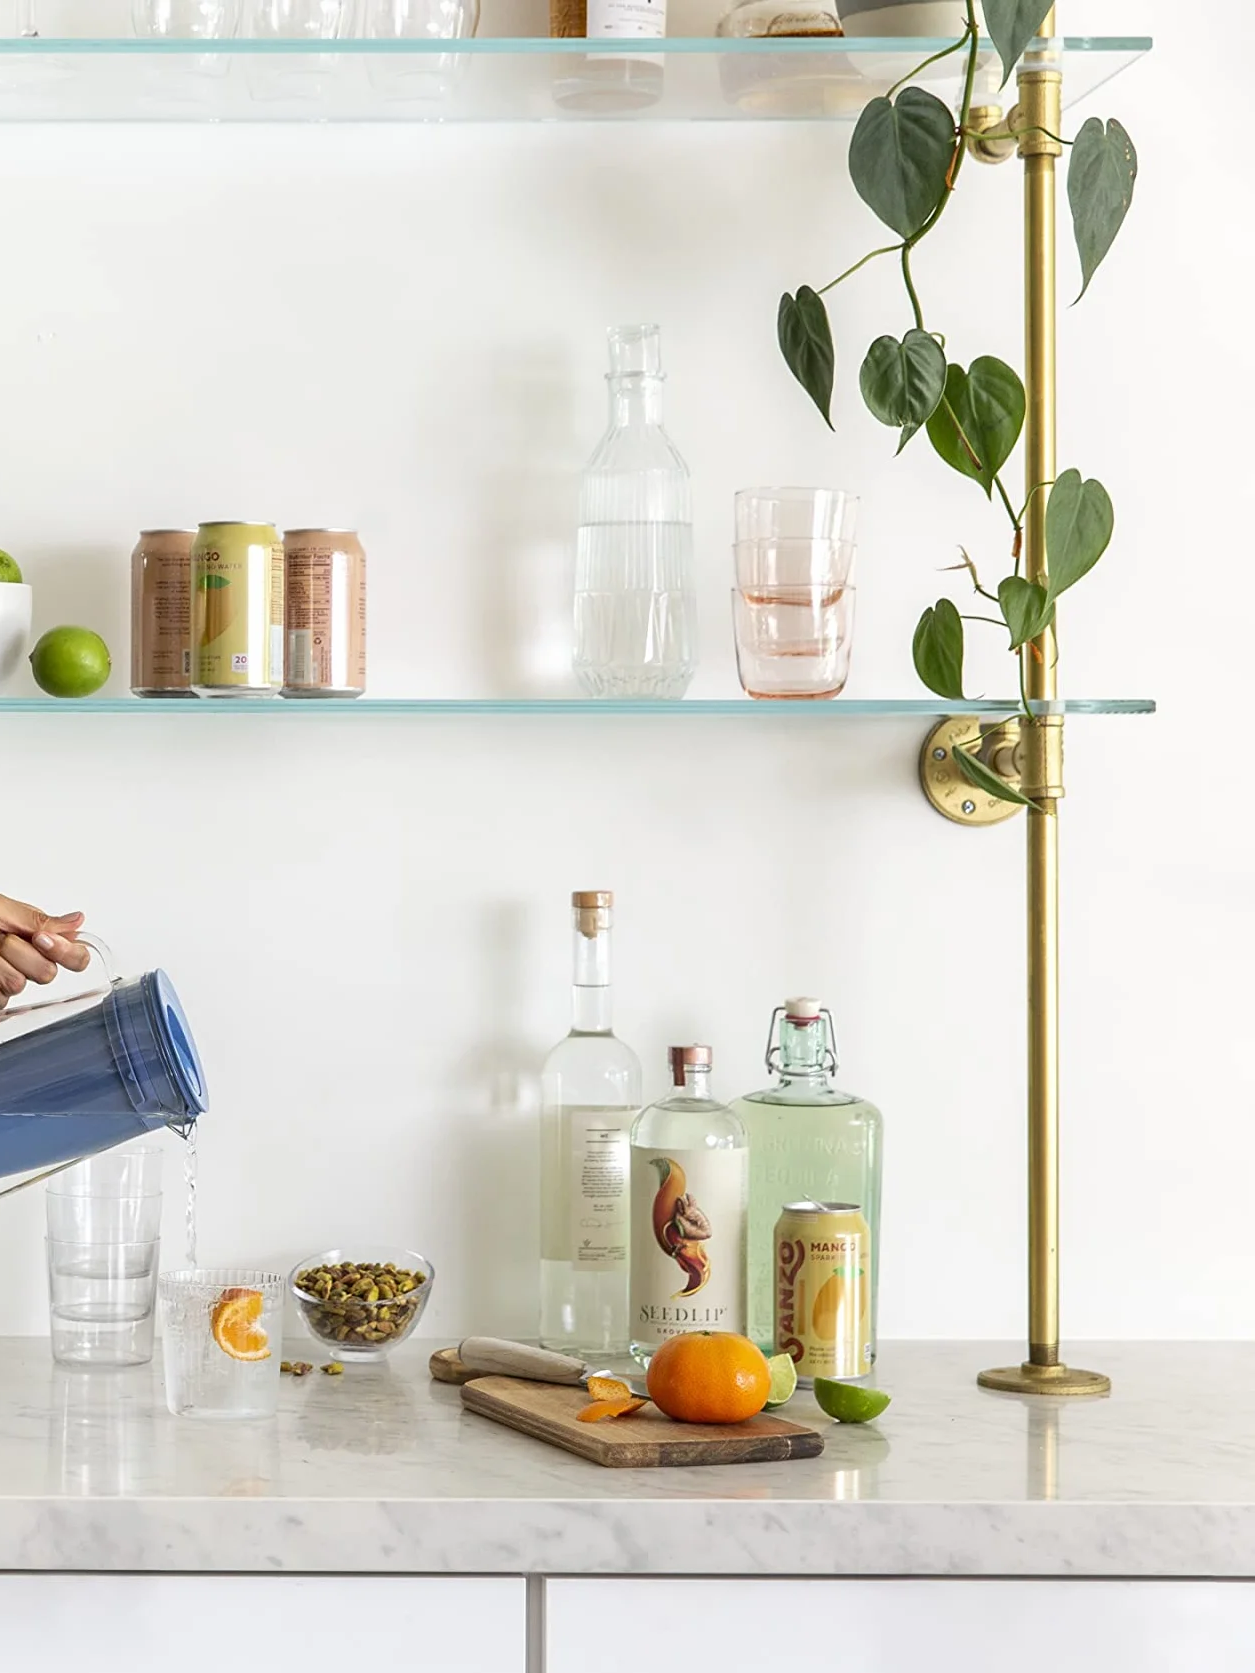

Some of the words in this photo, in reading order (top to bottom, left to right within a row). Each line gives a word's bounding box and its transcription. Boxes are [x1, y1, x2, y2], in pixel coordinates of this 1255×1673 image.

[235, 655, 247, 664] 20
[779, 1239, 805, 1364] SANZO
[640, 1304, 724, 1322] SEEDLIP
